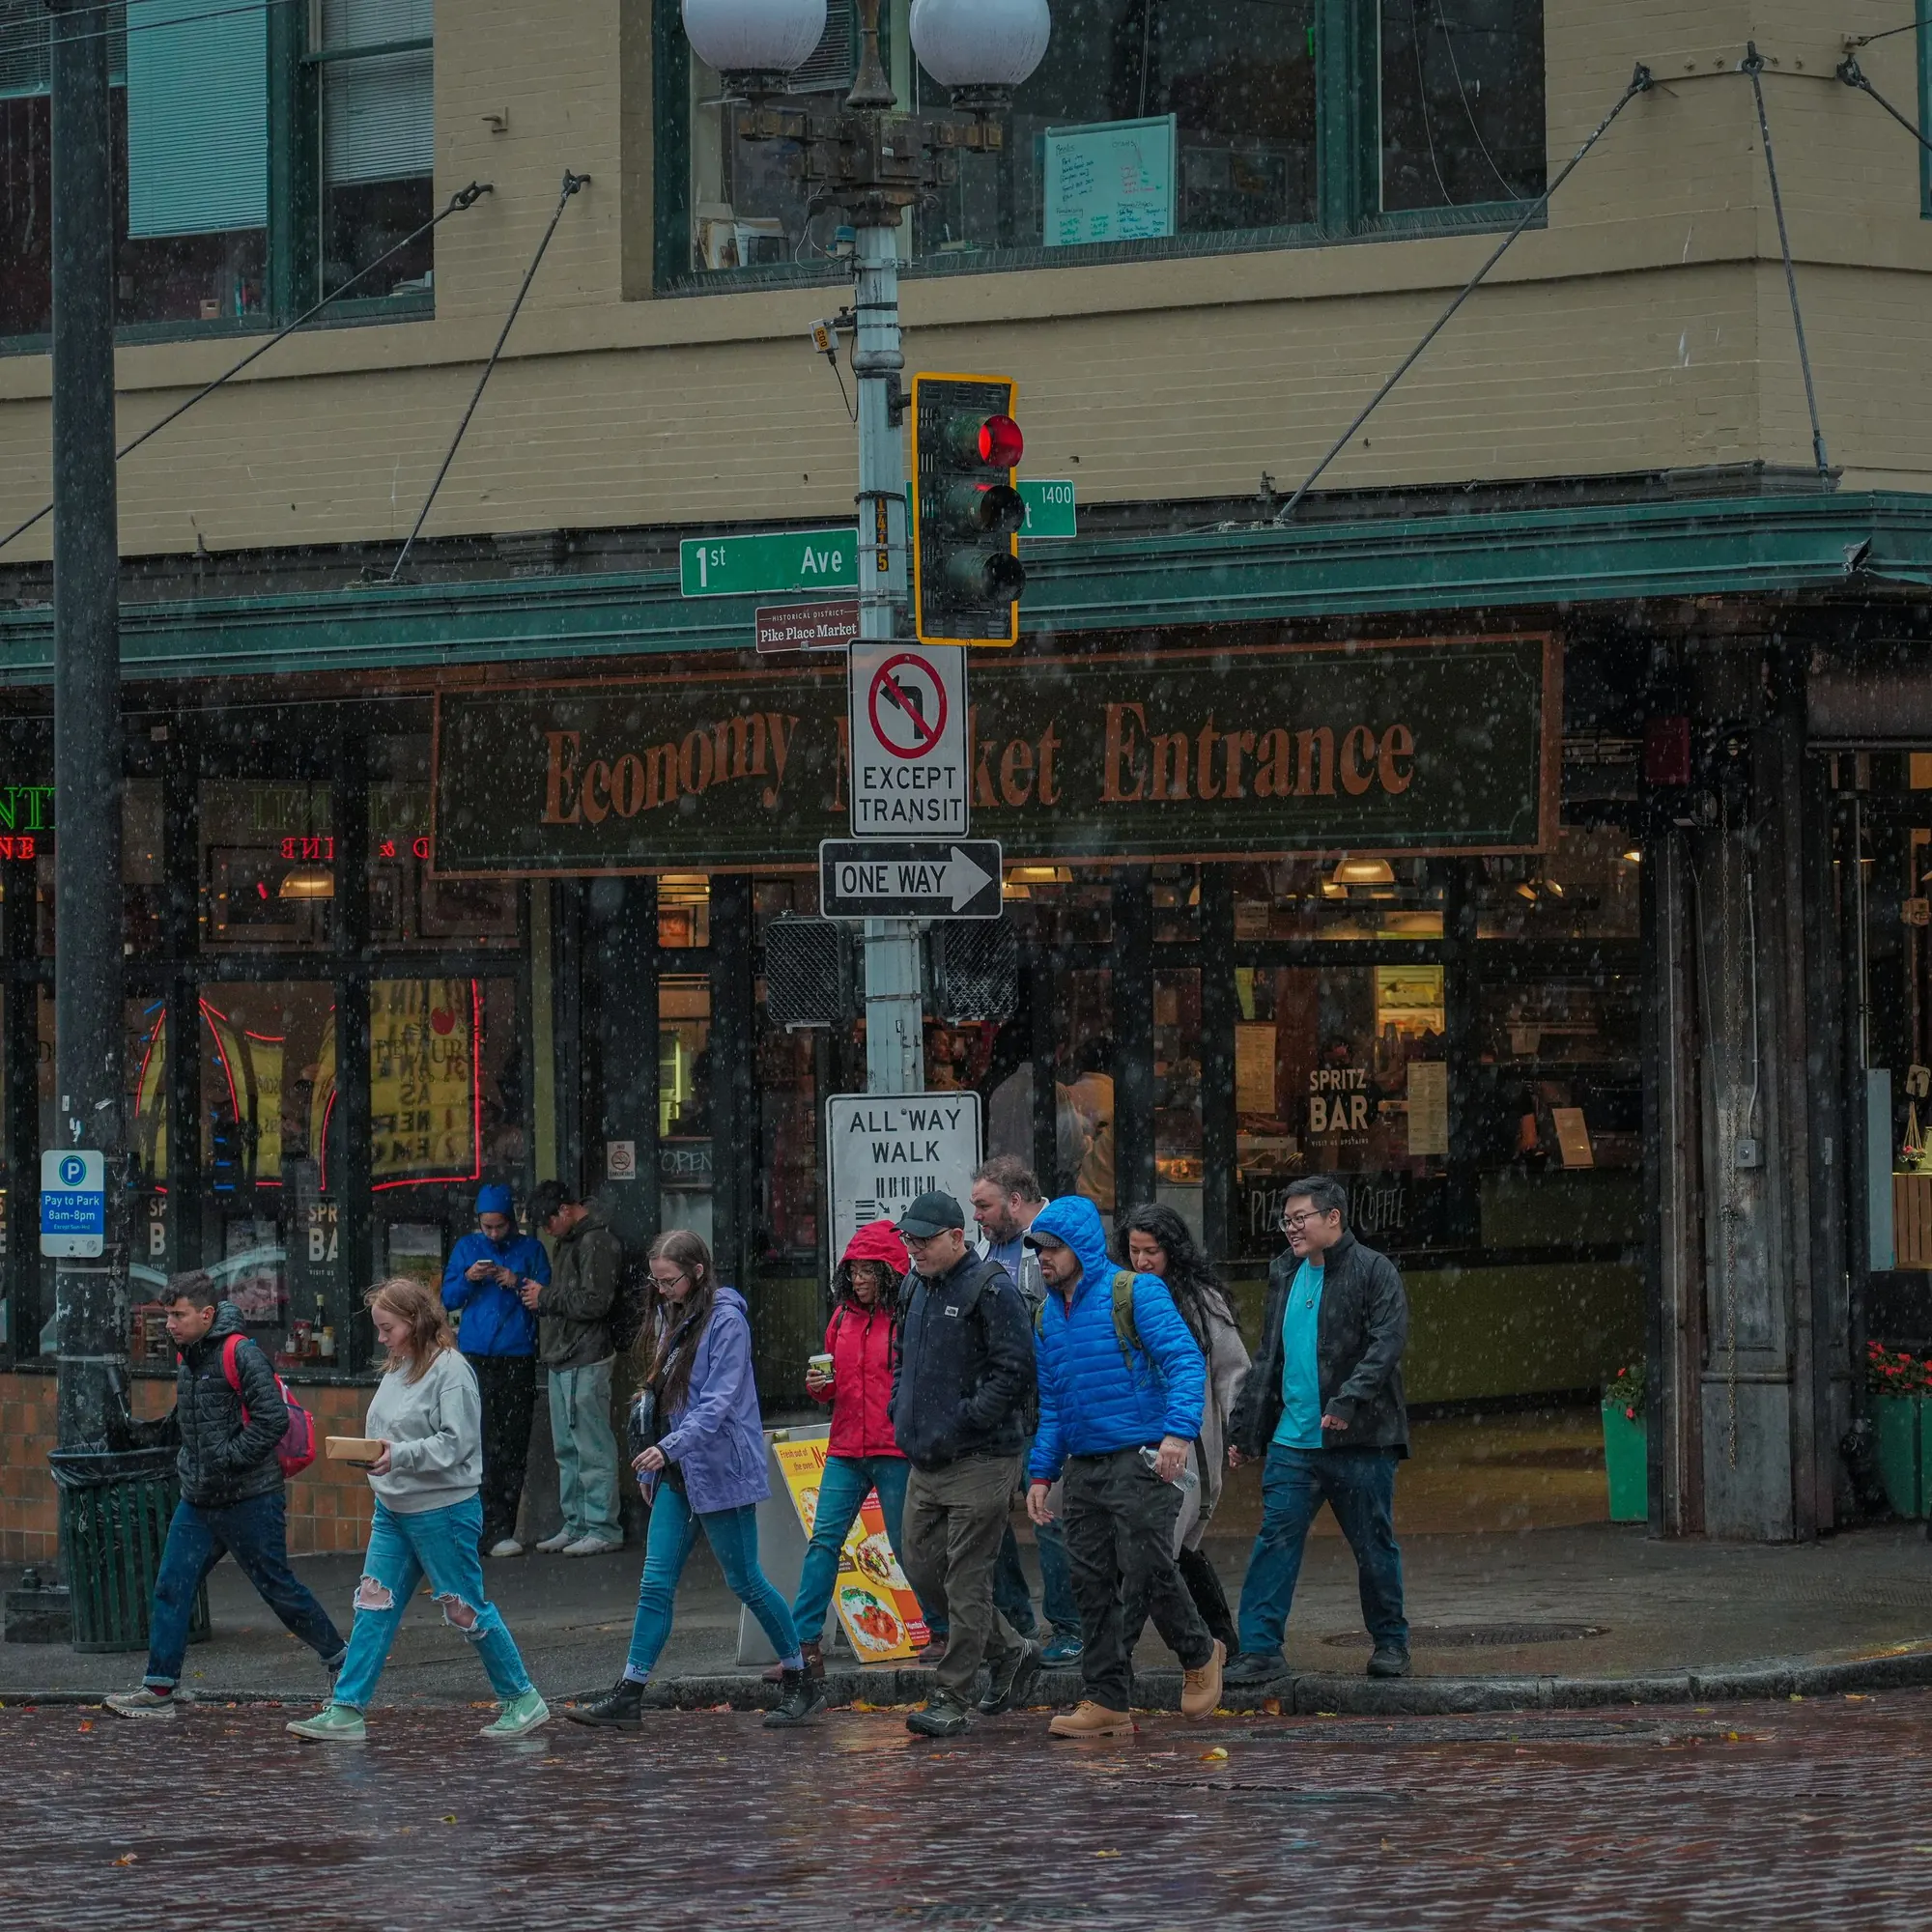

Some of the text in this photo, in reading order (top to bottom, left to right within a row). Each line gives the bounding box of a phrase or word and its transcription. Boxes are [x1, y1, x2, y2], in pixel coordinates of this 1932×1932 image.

[1041, 486, 1071, 504] 1400
[1024, 501, 1033, 528] t
[696, 546, 842, 587] 1st Ave
[772, 609, 845, 624] HISTORICAL DISTRICT
[760, 623, 858, 642] Pike Place Market
[541, 712, 800, 824] Economy
[1099, 701, 1415, 803] Entrance
[864, 766, 957, 790] EXCEPT
[859, 798, 963, 823] TRANSIT
[0, 837, 35, 860] NE
[841, 864, 947, 894] ONE WAY
[1308, 1068, 1367, 1092] SPRITZ
[850, 1109, 961, 1133] ALL WAY
[1309, 1094, 1369, 1132] BAR
[661, 1149, 713, 1173] OPEN
[871, 1141, 940, 1163] WALK
[44, 1195, 100, 1208] Pay to Park
[308, 1203, 338, 1223] SPR
[1251, 1188, 1287, 1236] PIZ
[1359, 1185, 1408, 1233] COFFEE
[48, 1210, 96, 1223] 8am-8pm
[308, 1227, 338, 1263] BA
